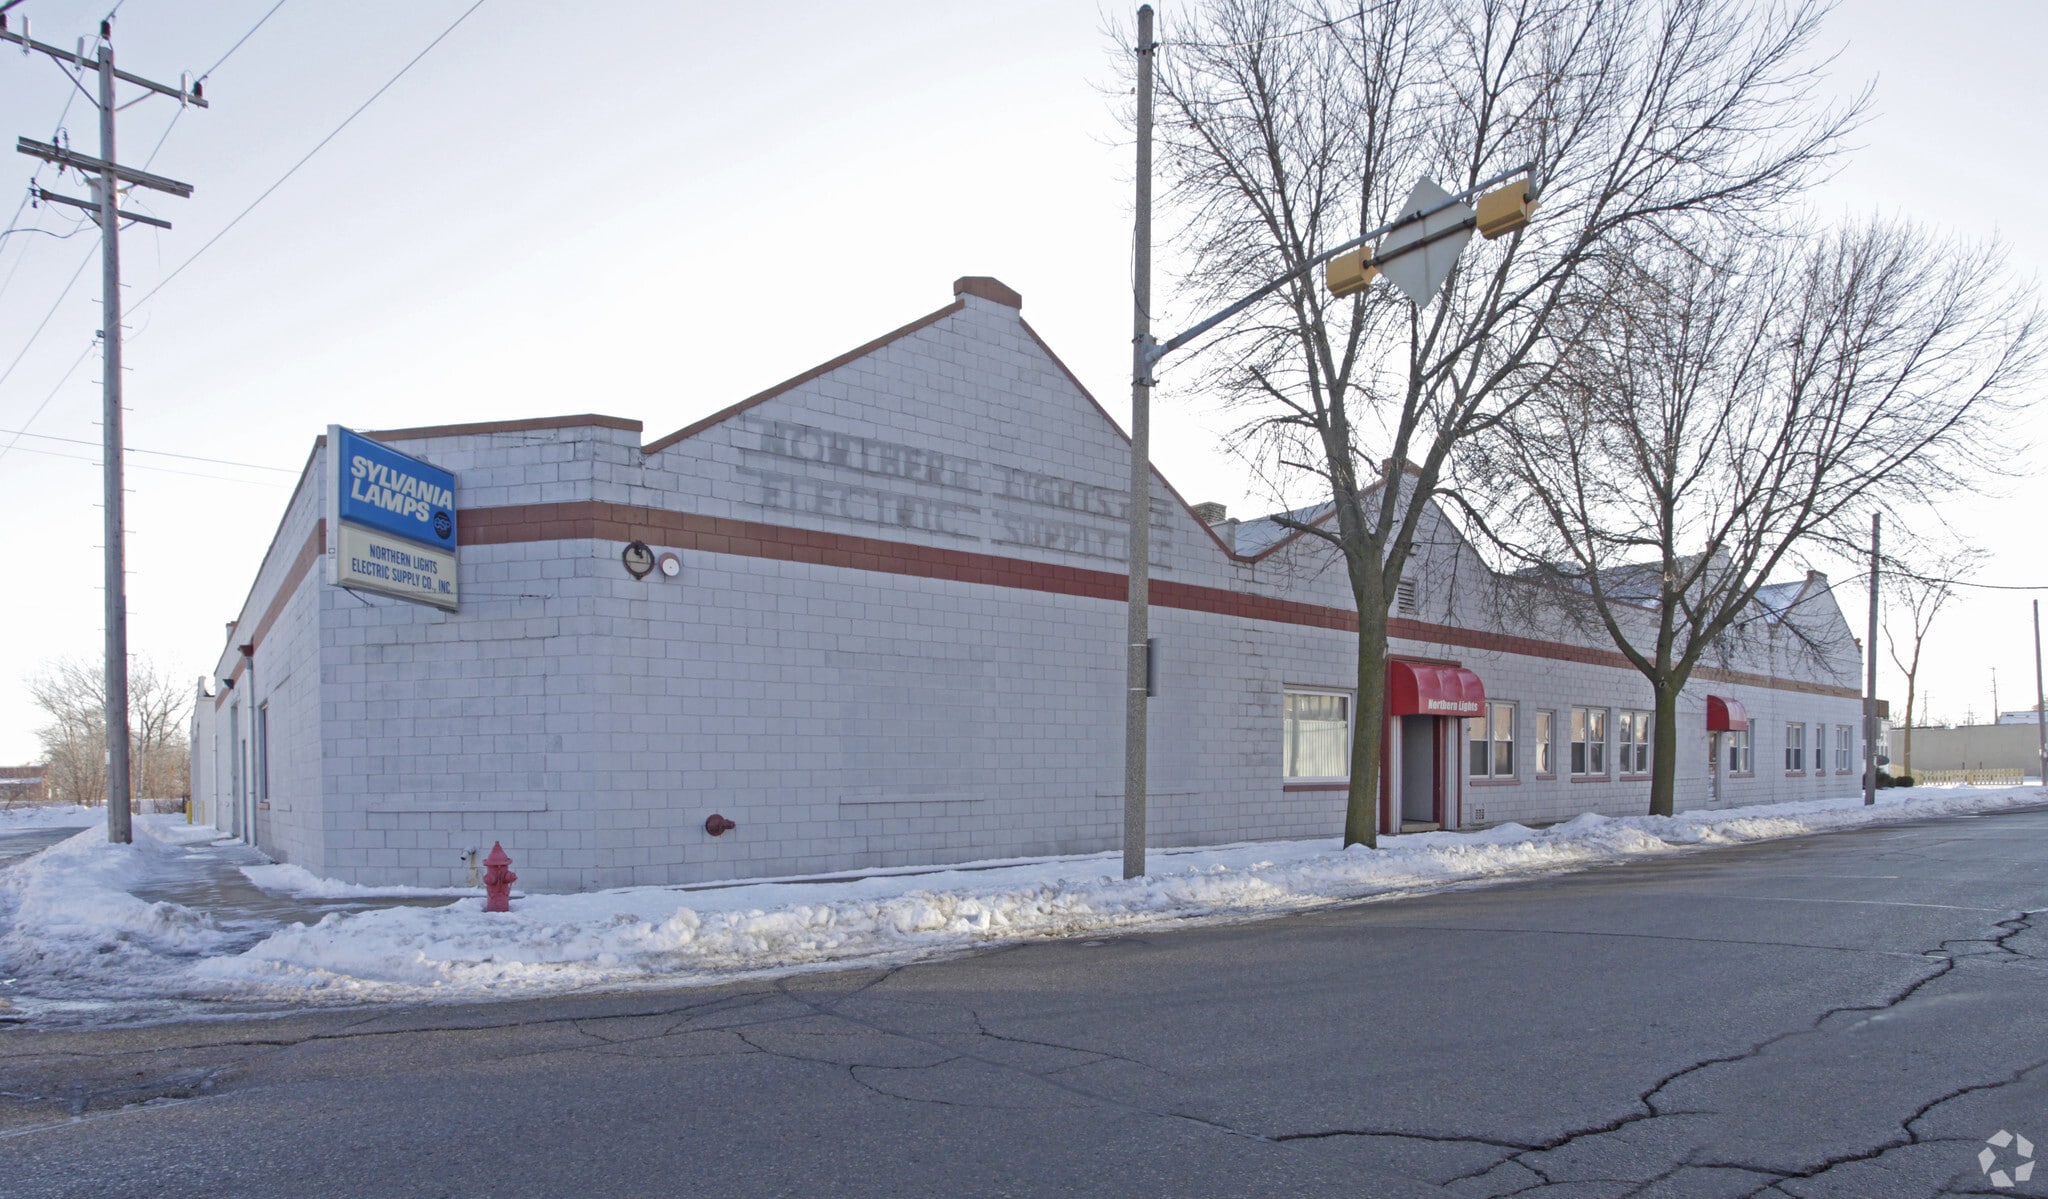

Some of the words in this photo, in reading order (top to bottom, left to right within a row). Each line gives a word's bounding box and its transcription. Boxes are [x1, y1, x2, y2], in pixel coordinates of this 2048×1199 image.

[351, 455, 453, 511] SYLVANIA
[351, 478, 430, 522] LAMPS
[352, 557, 389, 579] ELECTRIC
[391, 568, 420, 586] SUPPLY
[369, 544, 411, 567] NORTHERN
[413, 556, 438, 575] LIGHTS
[1428, 699, 1457, 710] Northern
[1458, 701, 1478, 712] Lights
